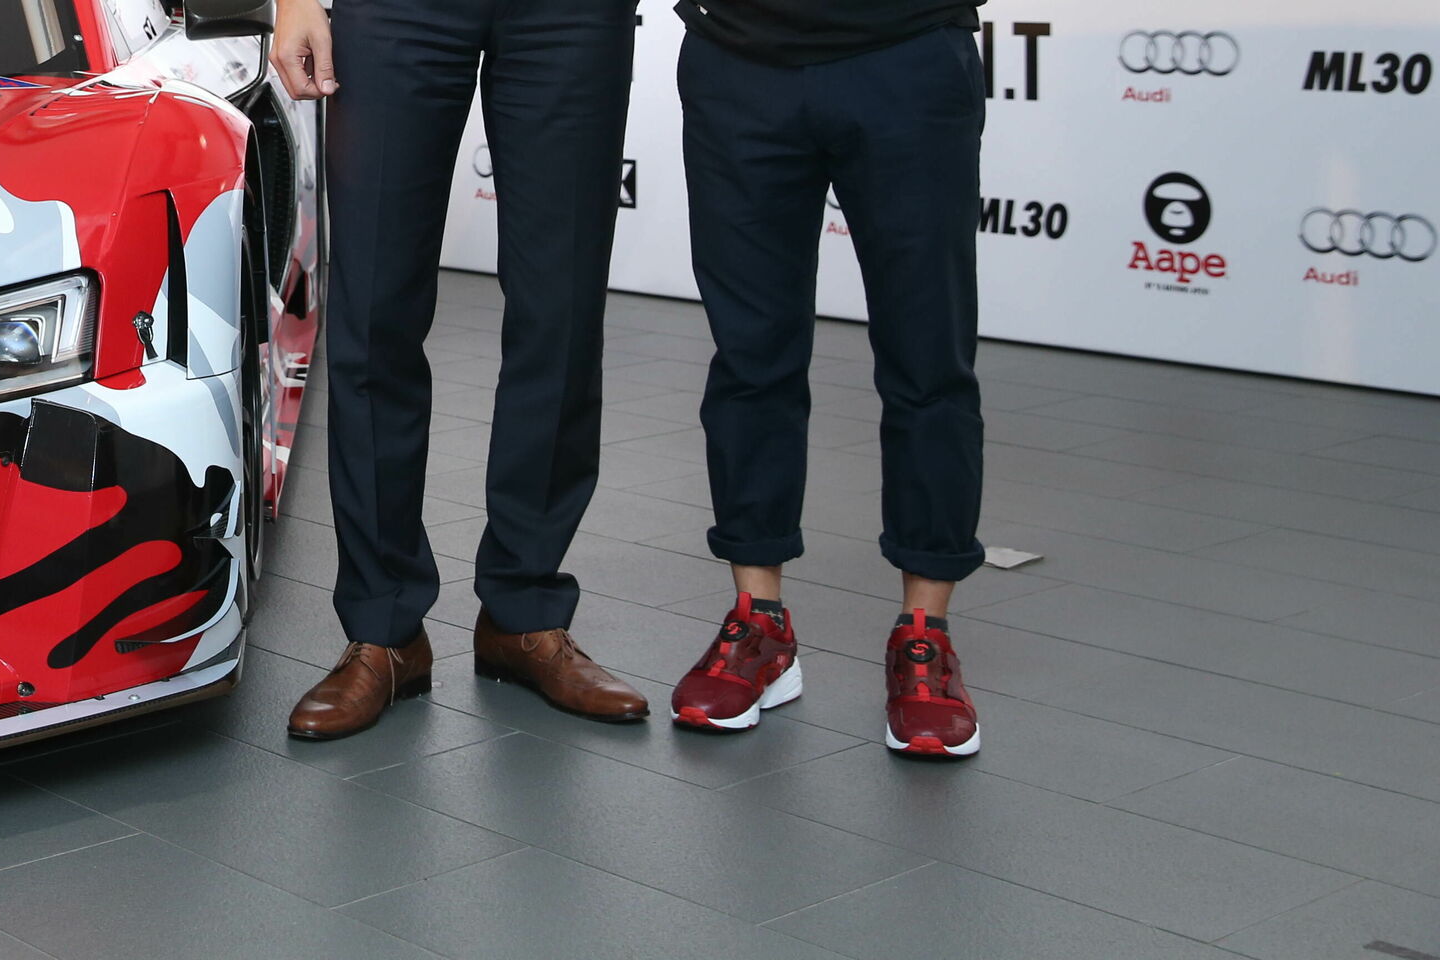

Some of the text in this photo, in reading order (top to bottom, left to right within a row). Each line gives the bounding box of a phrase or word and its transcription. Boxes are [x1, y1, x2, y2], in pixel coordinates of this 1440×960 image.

[983, 22, 1050, 100] I.T
[1303, 50, 1432, 95] ML30
[1123, 87, 1172, 103] Audi
[978, 197, 1069, 240] ML30
[1128, 240, 1226, 283] Aape
[1303, 267, 1360, 287] Audi
